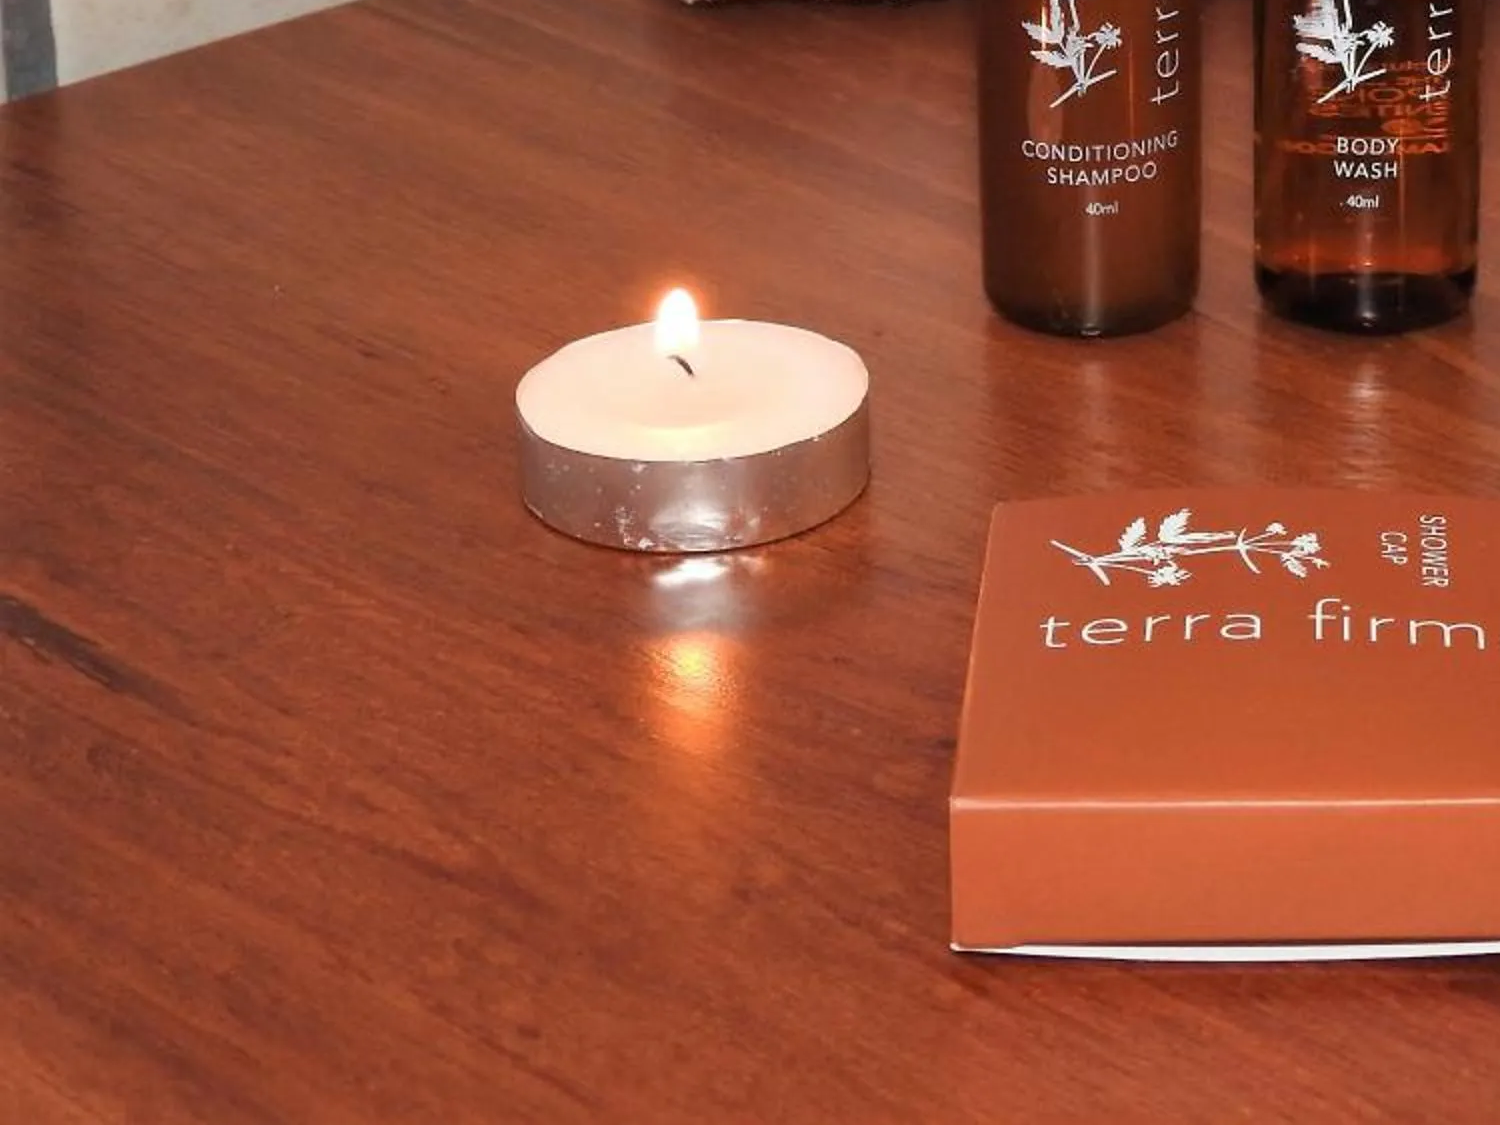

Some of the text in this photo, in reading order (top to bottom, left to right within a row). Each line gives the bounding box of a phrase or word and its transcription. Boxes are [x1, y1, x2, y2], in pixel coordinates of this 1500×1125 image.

[1021, 130, 1178, 164] CONDITIONING
[1335, 136, 1400, 156] BODY
[1046, 161, 1158, 187] SHAMPOO
[1333, 158, 1399, 179] WASH
[1085, 200, 1119, 217] 40ml
[1346, 193, 1379, 209] 40ml
[1381, 531, 1408, 566] CAP
[1419, 514, 1449, 588] SHOWER
[1039, 613, 1262, 649] terra
